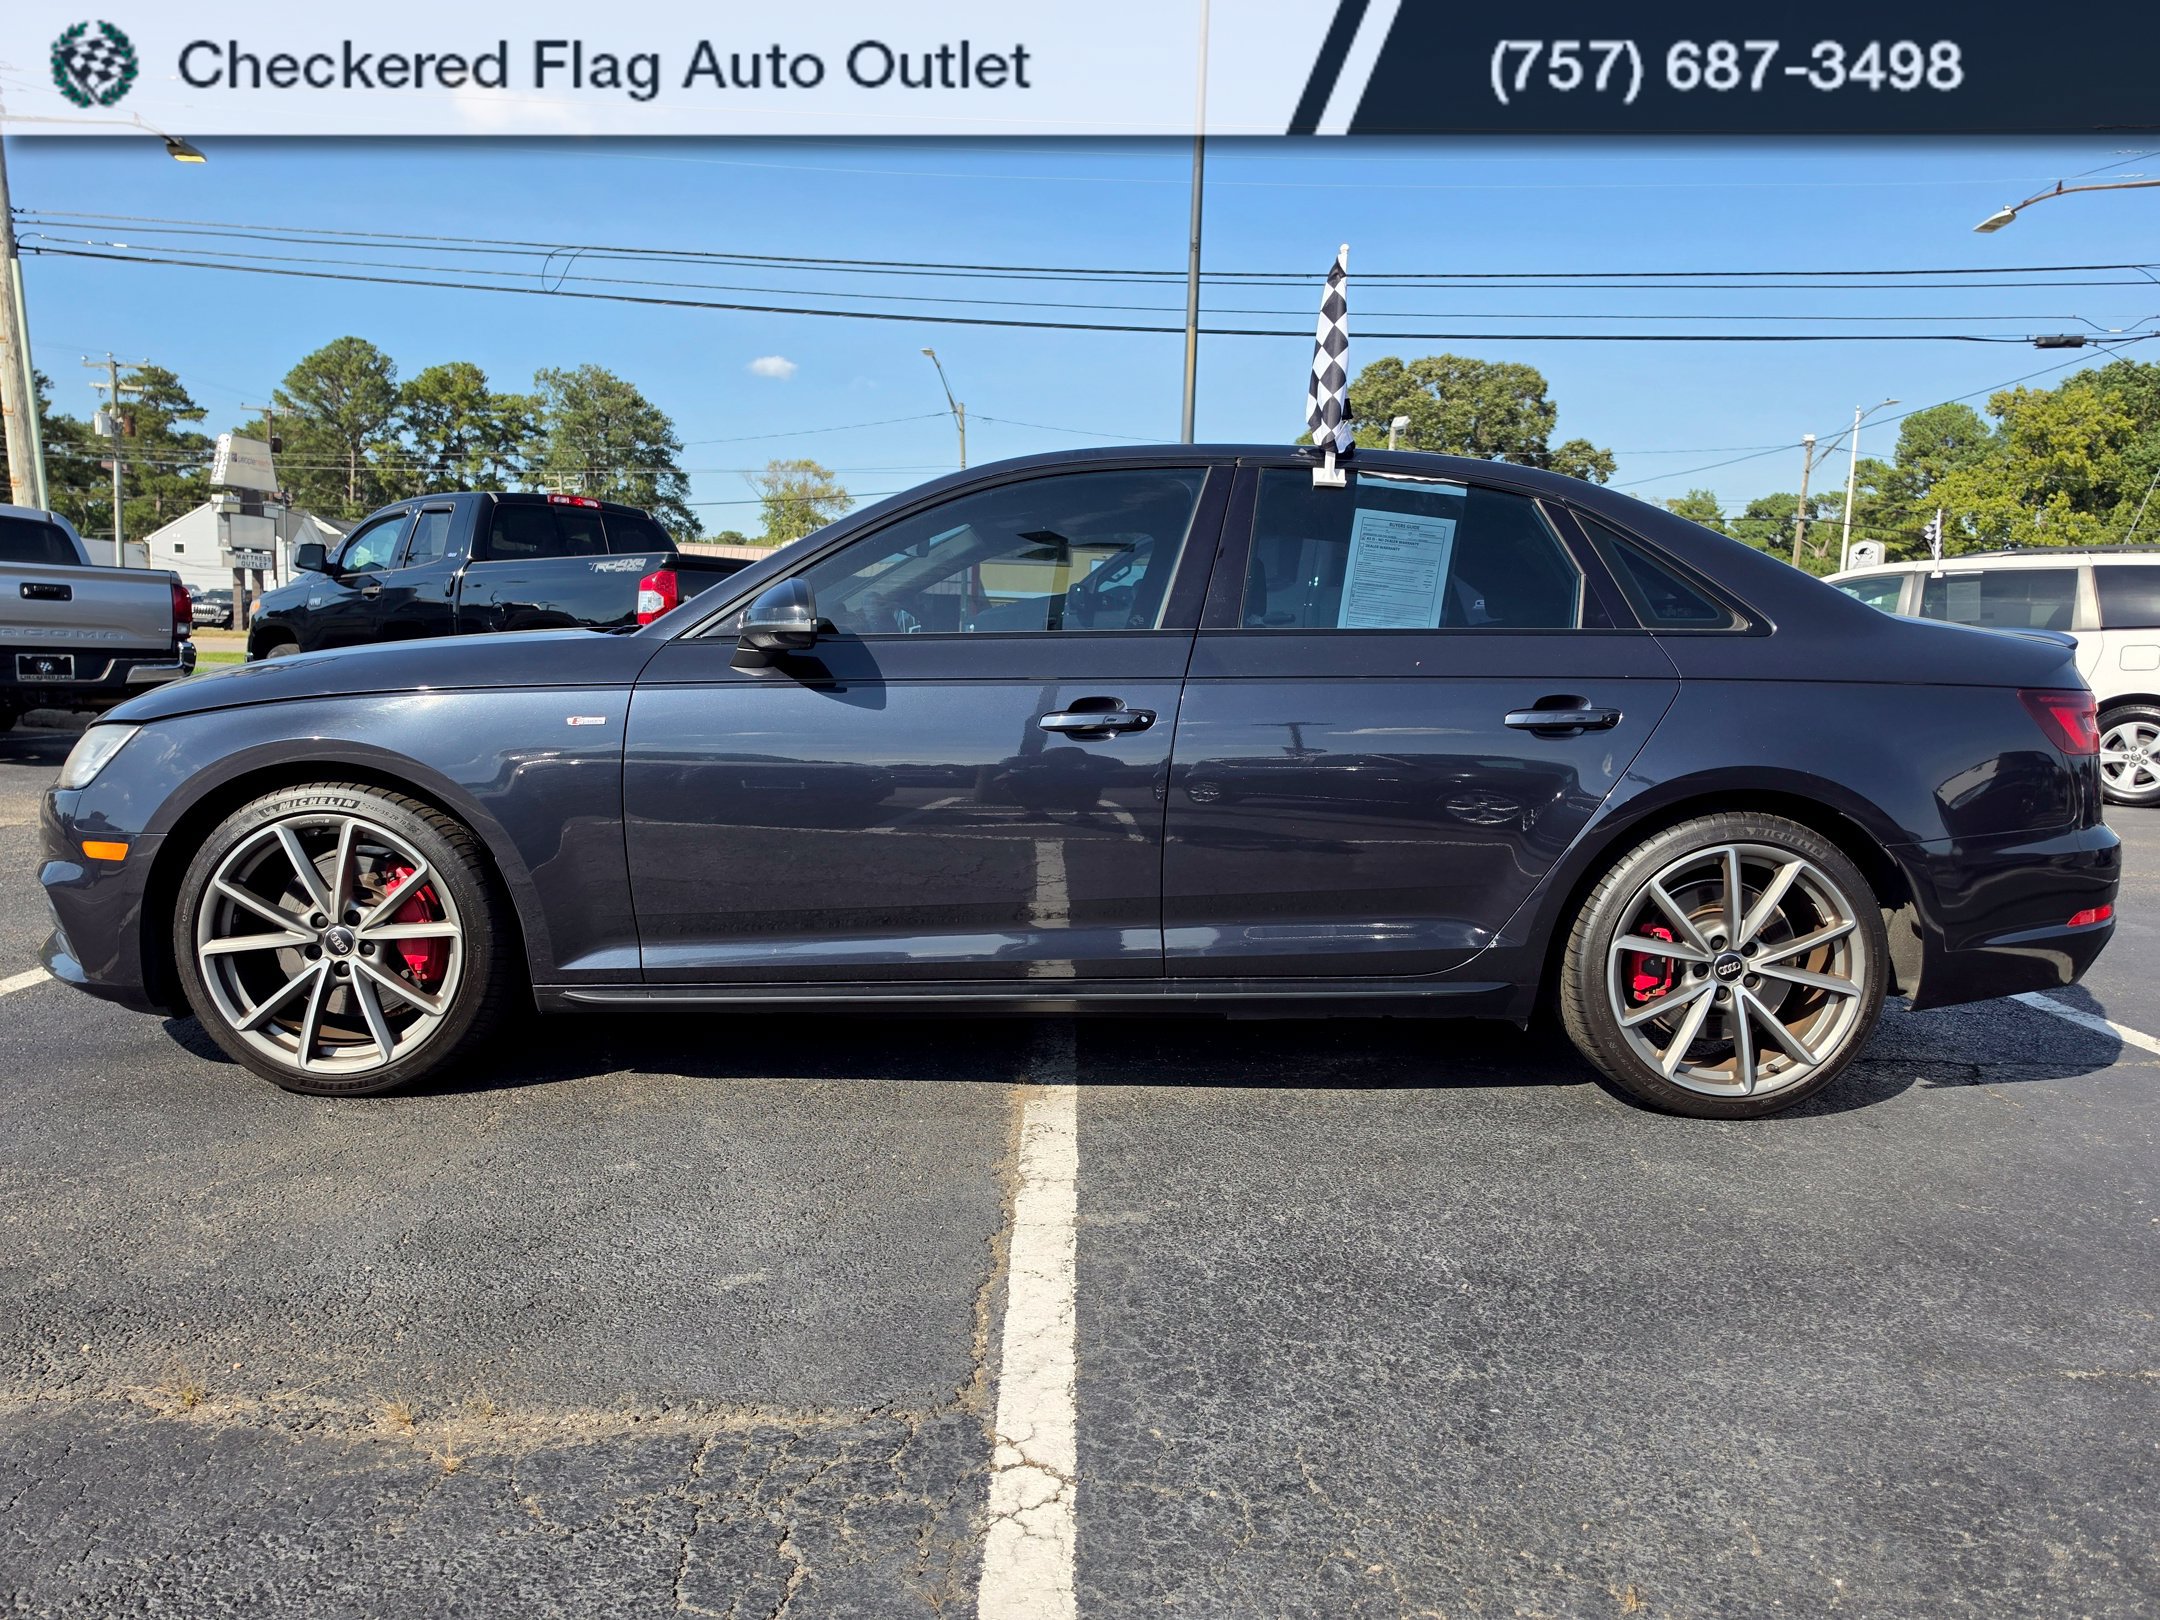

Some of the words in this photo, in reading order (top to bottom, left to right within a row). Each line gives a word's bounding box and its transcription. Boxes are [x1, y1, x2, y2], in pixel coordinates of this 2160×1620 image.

[236, 553, 271, 563] MATTRESS
[241, 560, 267, 568] OUTLET
[280, 797, 356, 810] MICHELIN
